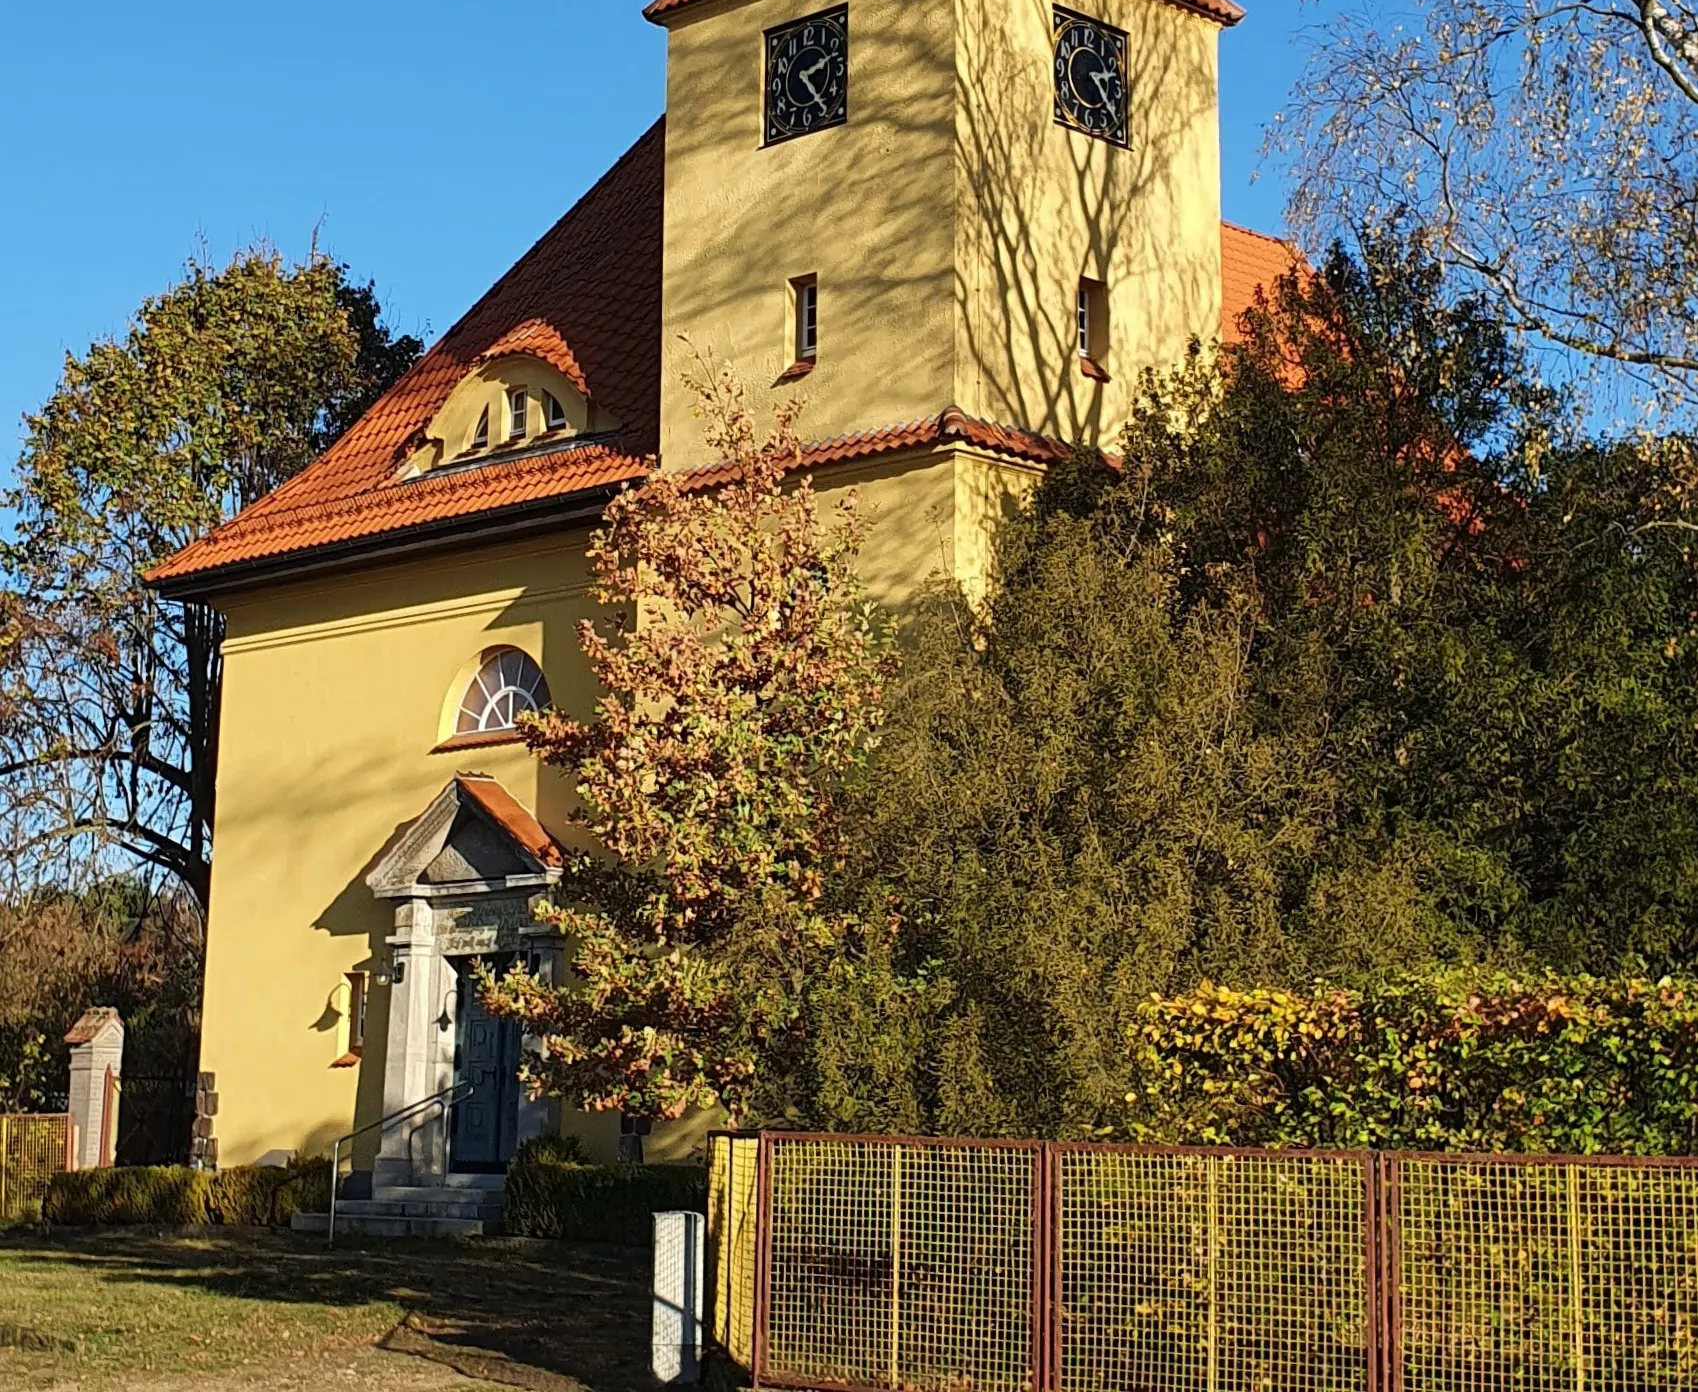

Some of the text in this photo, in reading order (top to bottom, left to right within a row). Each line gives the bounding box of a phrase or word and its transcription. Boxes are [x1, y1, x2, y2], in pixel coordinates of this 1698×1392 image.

[804, 27, 814, 46] 12
[1071, 29, 1078, 47] 11
[1084, 29, 1094, 48] 12
[789, 39, 796, 56] 11
[830, 38, 839, 57] 2
[1061, 40, 1070, 58] 10
[778, 57, 788, 75] 10
[836, 57, 844, 76] 3
[1056, 58, 1064, 77] 9
[1108, 57, 1116, 77] 2
[772, 78, 781, 96] 9
[829, 78, 838, 96] 4
[1061, 82, 1069, 100] 8
[1114, 80, 1122, 99] 3
[777, 98, 786, 116] 8
[1072, 100, 1080, 117] 7
[790, 107, 797, 126] 7
[803, 108, 812, 126] 6
[1085, 109, 1092, 127] 6
[1100, 109, 1107, 128] 5
